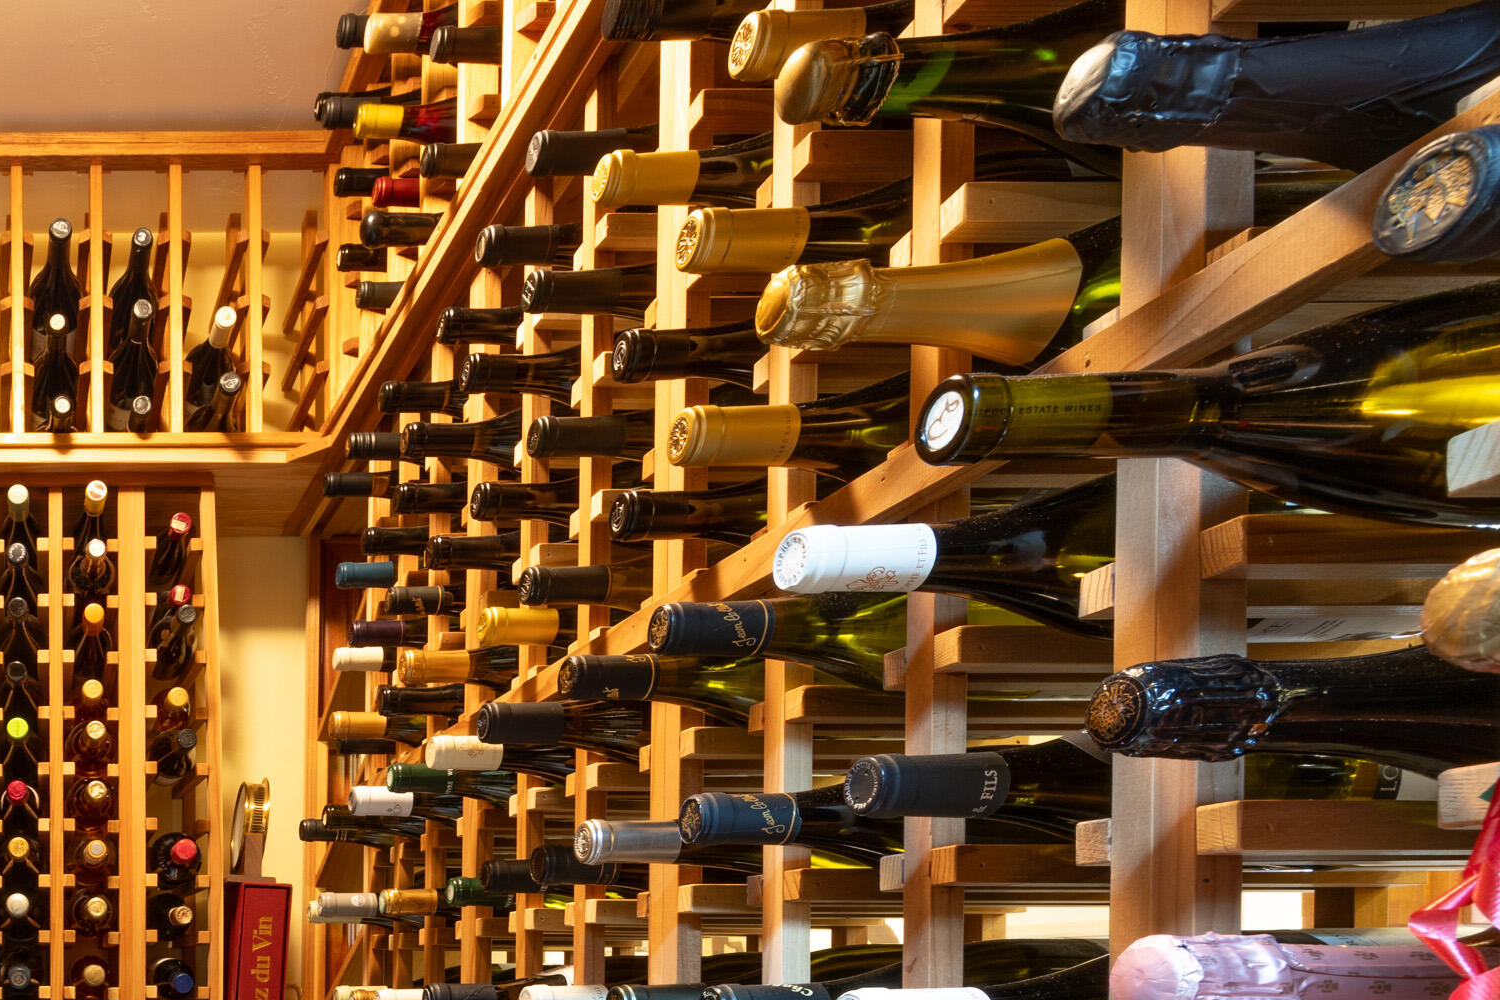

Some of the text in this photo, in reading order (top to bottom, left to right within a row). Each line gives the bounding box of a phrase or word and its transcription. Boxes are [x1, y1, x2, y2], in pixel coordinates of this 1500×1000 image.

[1018, 404, 1060, 415] ESTATE
[1064, 404, 1101, 413] WINES
[980, 769, 998, 801] FILS
[251, 915, 274, 952] Vin
[250, 955, 271, 984] du
